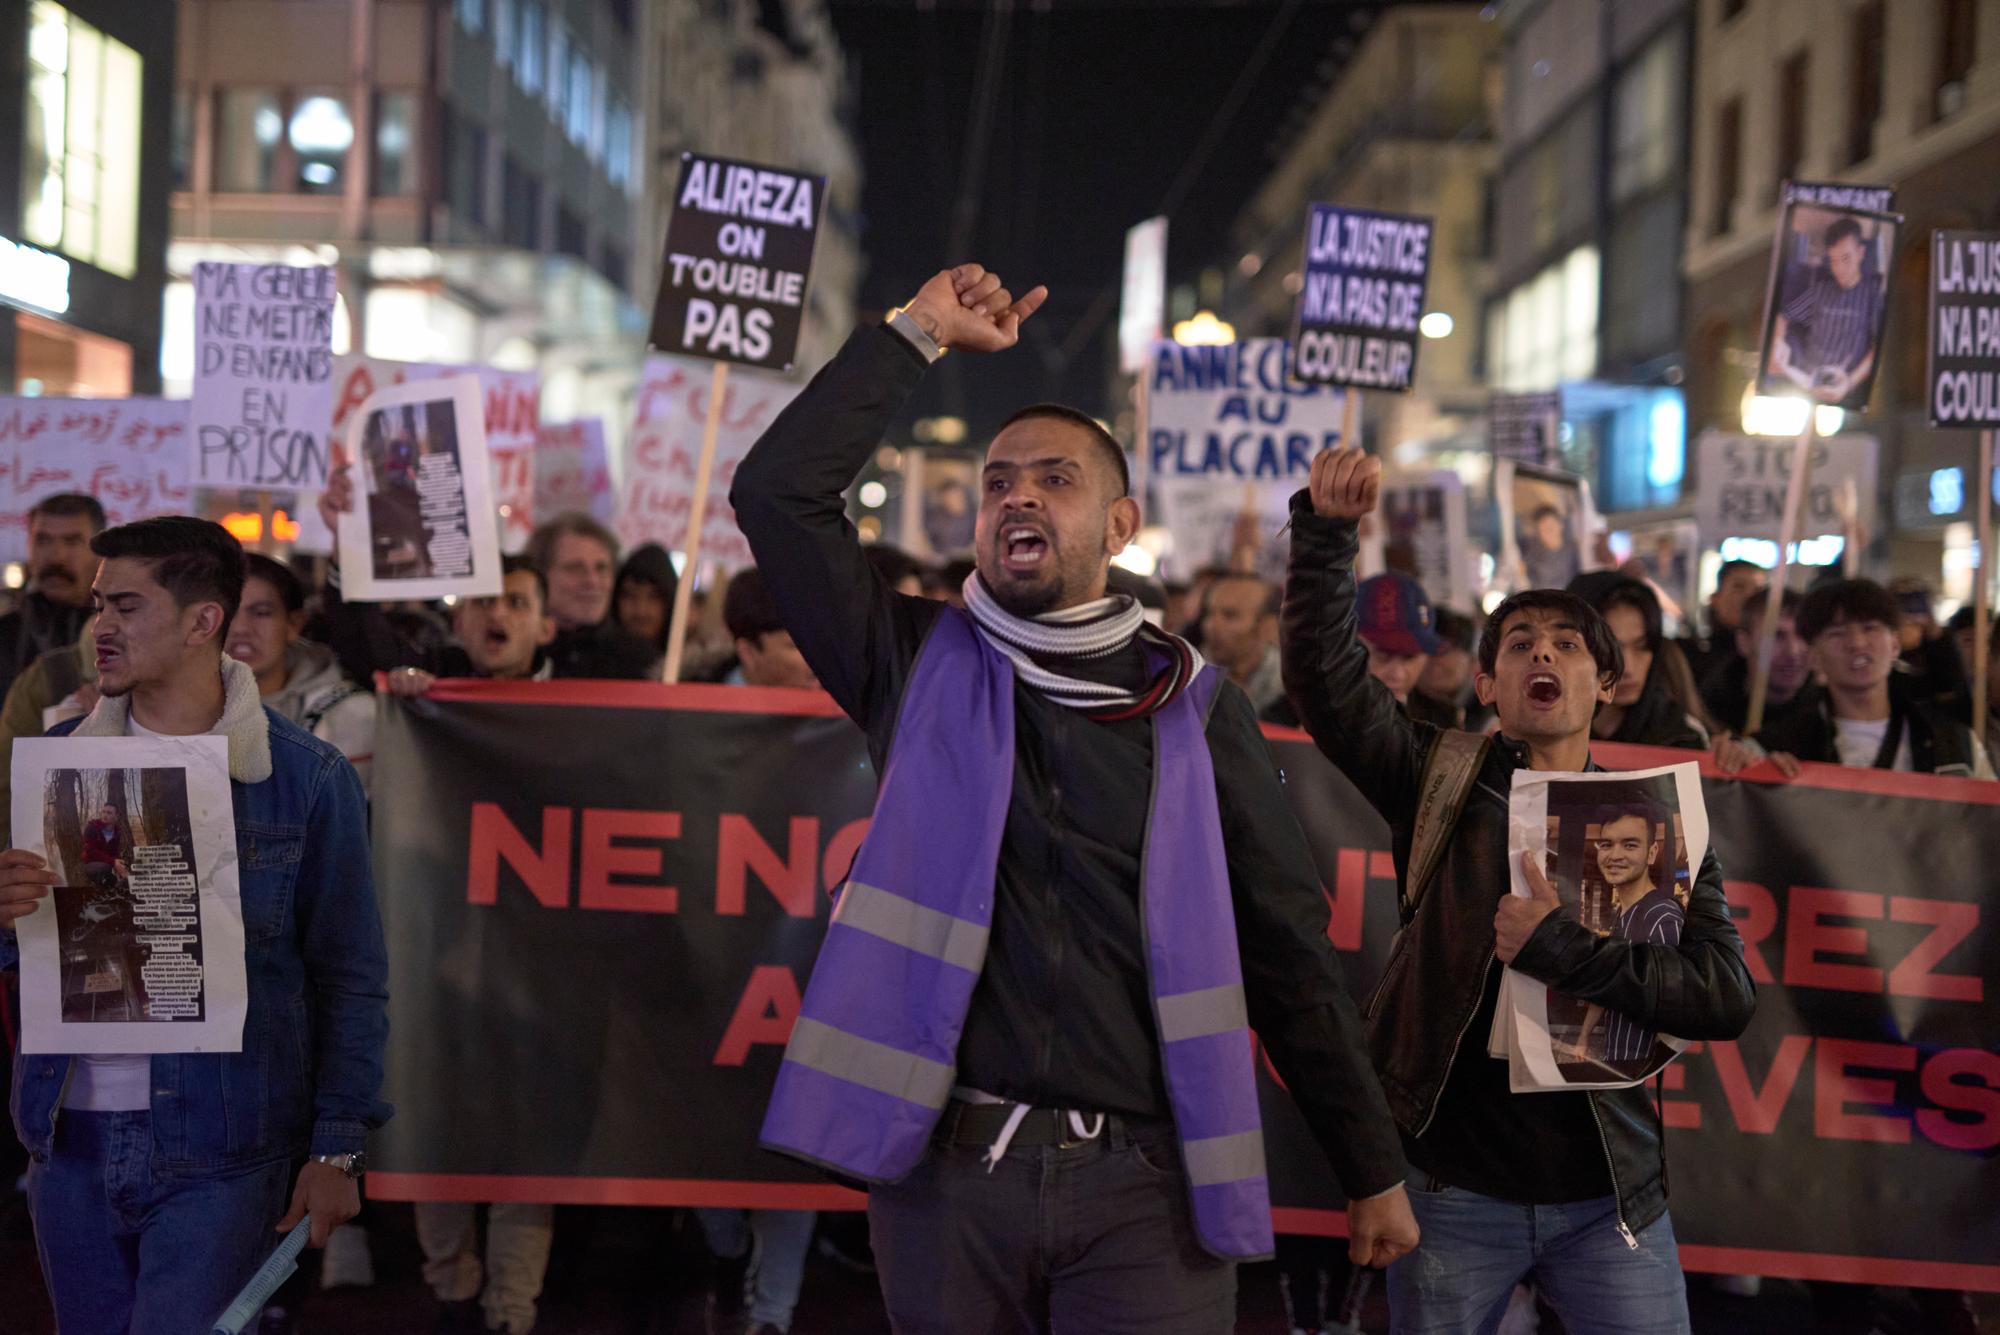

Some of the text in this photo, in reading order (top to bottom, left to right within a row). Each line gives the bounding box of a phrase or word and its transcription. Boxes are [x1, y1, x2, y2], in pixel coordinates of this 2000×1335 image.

[681, 160, 813, 229] ALIREZA
[718, 222, 765, 259] ON
[1309, 211, 1430, 275] LA JUSTICE
[1937, 240, 1965, 293] LA
[199, 261, 241, 298] MA
[669, 253, 803, 305] T'OUBLIE
[1303, 270, 1423, 332] N'A PAS DE
[203, 302, 242, 339] NE
[682, 297, 773, 361] PAS
[1938, 306, 1973, 357] N'A
[1299, 330, 1412, 389] COULEUR
[243, 387, 288, 427] EN
[1217, 395, 1288, 425] AU
[1935, 368, 2000, 421] COUL
[199, 424, 334, 487] PRISON
[467, 802, 682, 914] NE
